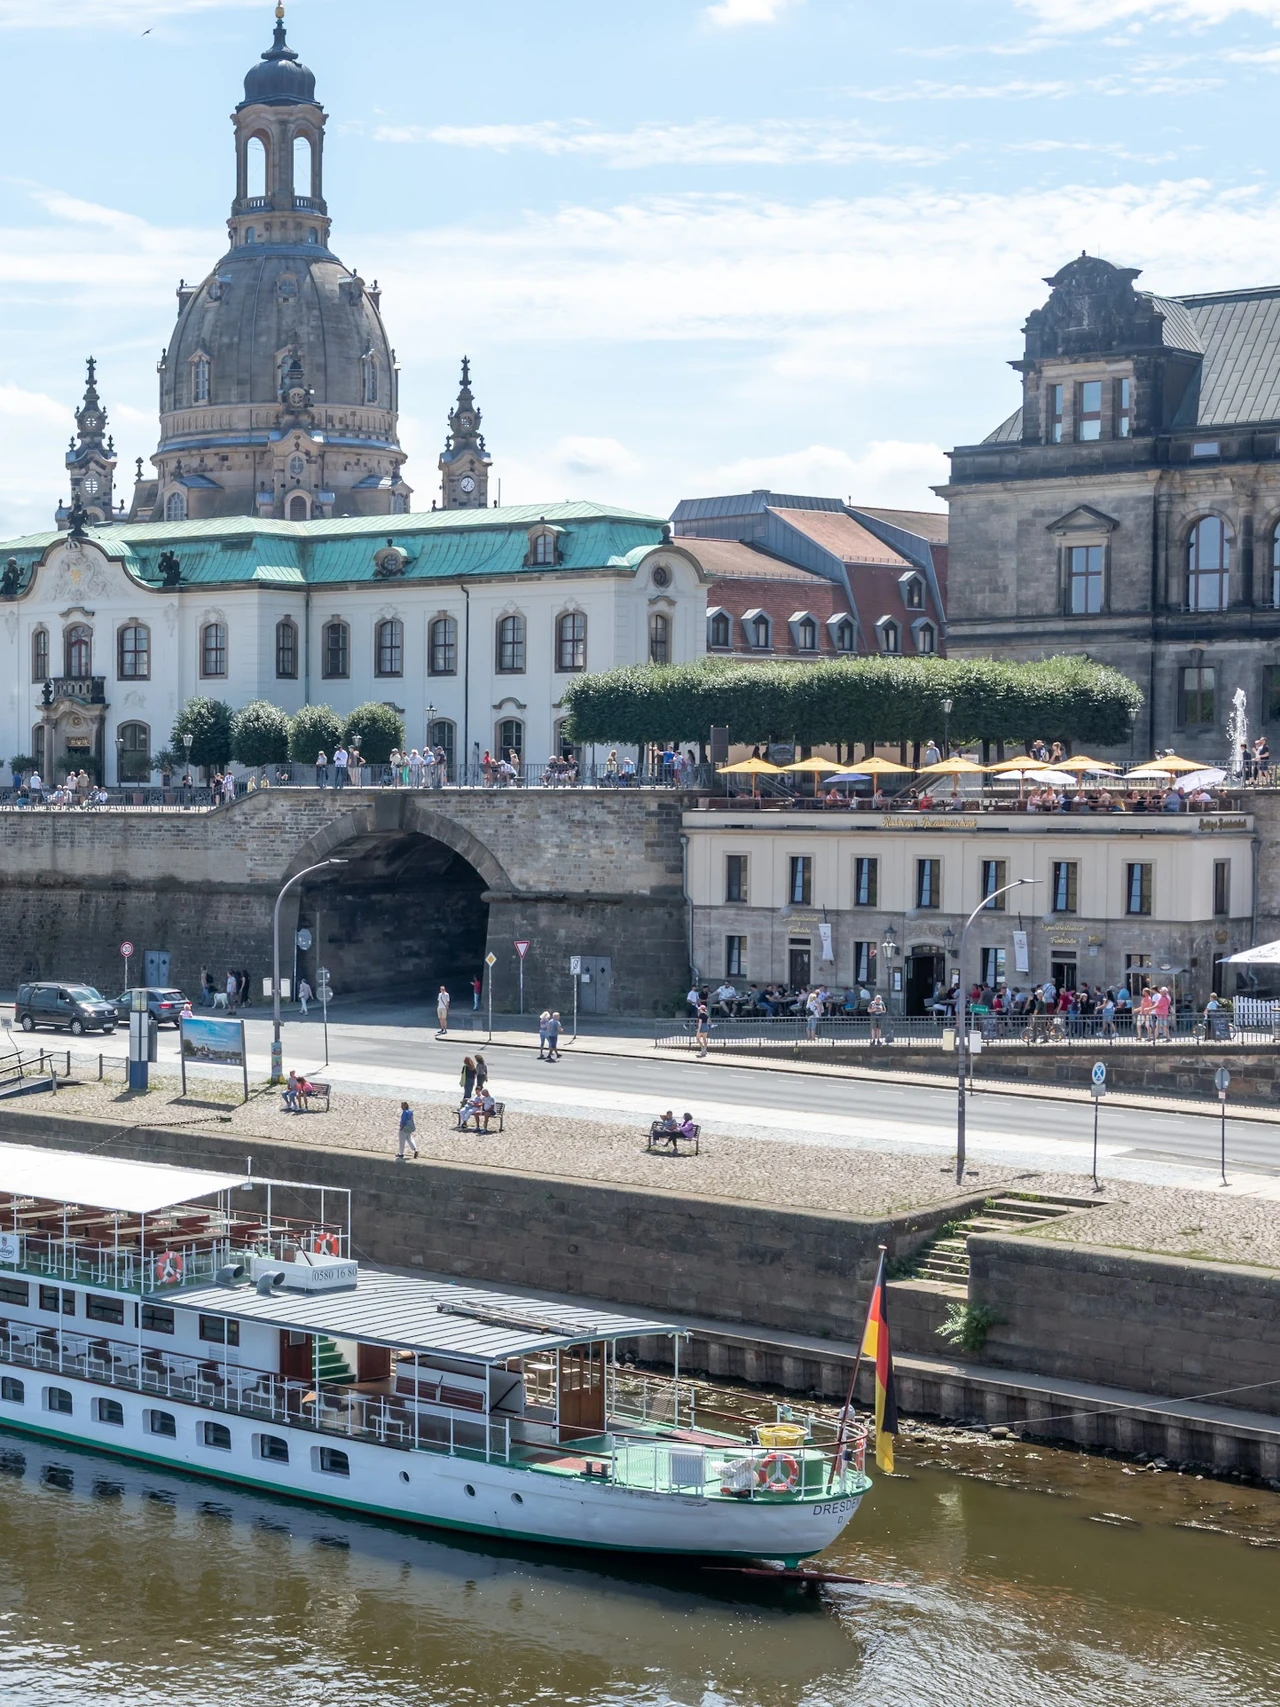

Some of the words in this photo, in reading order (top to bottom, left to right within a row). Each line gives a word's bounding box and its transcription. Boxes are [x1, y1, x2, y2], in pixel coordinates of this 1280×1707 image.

[314, 1269, 334, 1281] 0580
[336, 1268, 345, 1279] 16
[347, 1267, 357, 1277] 80
[837, 1515, 844, 1524] D
